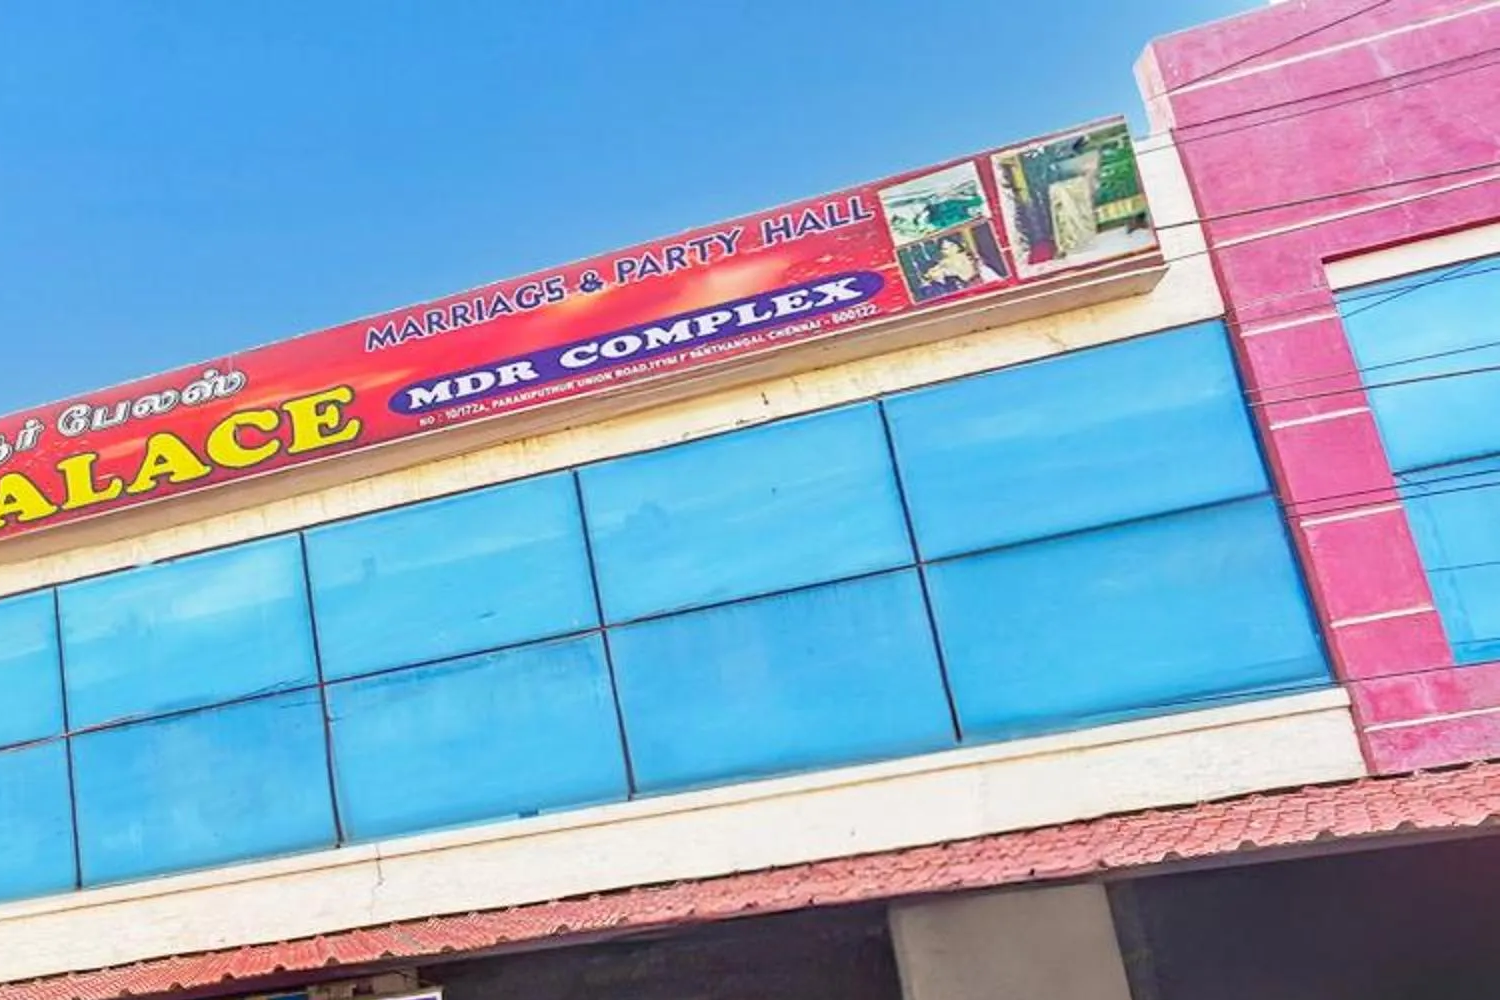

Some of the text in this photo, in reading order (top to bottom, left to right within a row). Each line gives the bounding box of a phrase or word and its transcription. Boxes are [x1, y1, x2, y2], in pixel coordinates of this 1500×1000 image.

[578, 270, 605, 295] &
[612, 228, 743, 284] PARTY
[760, 195, 877, 248] HALL
[407, 276, 864, 410] MDR COMPLEX
